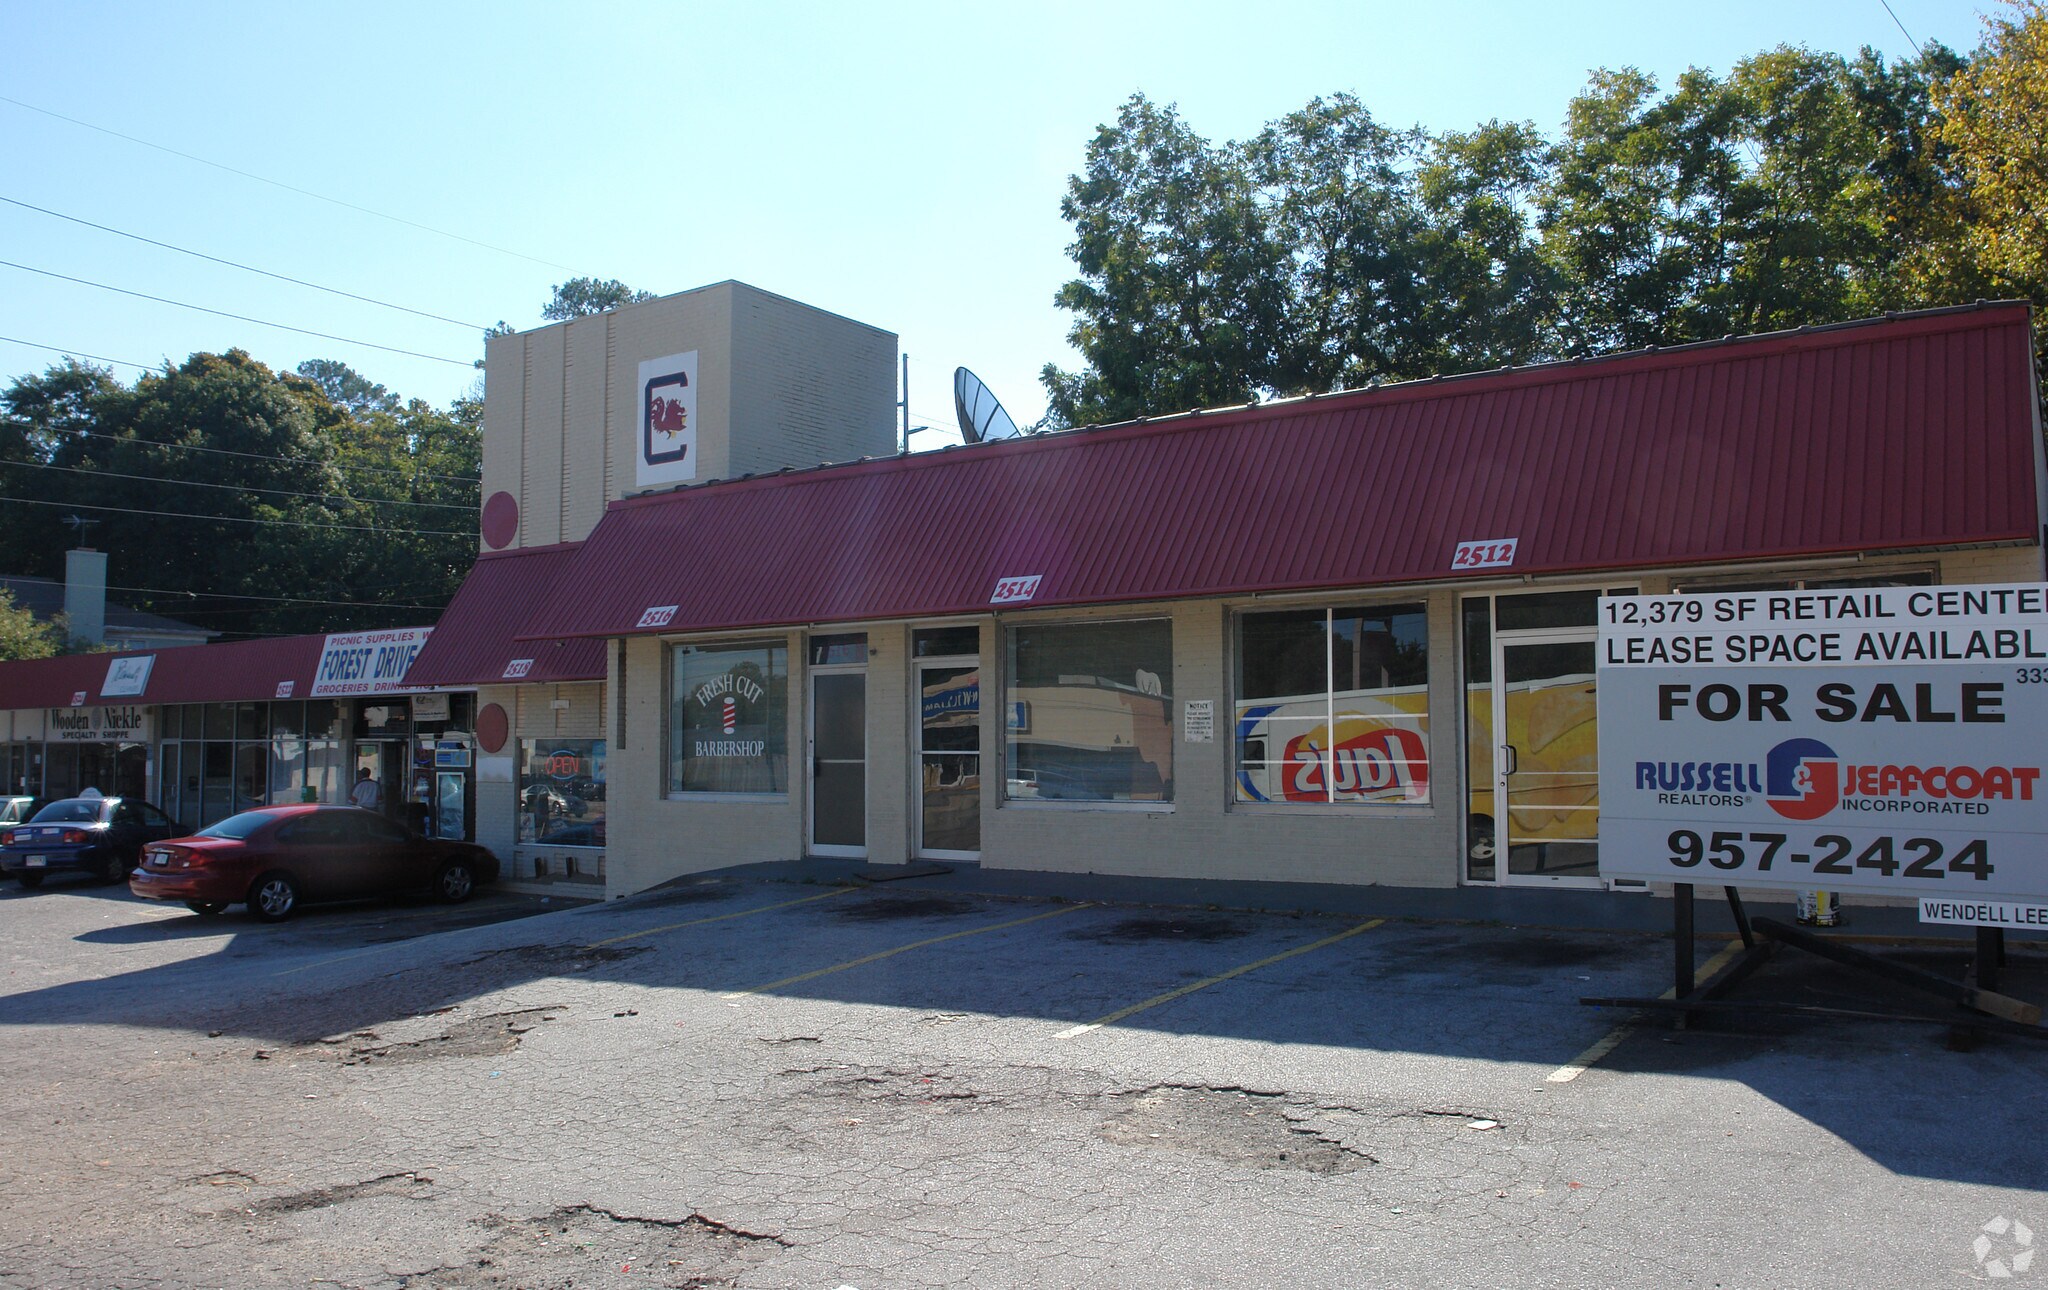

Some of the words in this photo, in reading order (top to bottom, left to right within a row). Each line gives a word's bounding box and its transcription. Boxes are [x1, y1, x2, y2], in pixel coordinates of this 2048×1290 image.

[1455, 544, 1513, 566] 2512
[994, 579, 1038, 599] 2514
[640, 608, 673, 625] 2516
[1606, 600, 1703, 628] 12,379
[1714, 598, 1756, 621] SF
[1769, 594, 1896, 620] RETAIL
[1908, 589, 2048, 617] CENTE
[331, 635, 362, 646] PICNIC
[366, 632, 415, 644] SUPPLIES
[1607, 636, 1714, 664] LEASE
[1725, 633, 1841, 662] SPACE
[1854, 629, 2047, 660] AVAILABL
[320, 648, 373, 681] FOREST
[373, 645, 418, 678] DRIVE
[505, 661, 531, 676] 2518
[316, 683, 369, 694] GROCERIES
[695, 674, 733, 707] FRESH
[736, 675, 764, 704] CUT
[1659, 683, 1792, 722] FOR
[1815, 683, 2006, 722] SALE
[52, 708, 89, 730] Wooden
[104, 707, 142, 728] Nickle
[62, 731, 97, 739] SPECIALTY
[695, 740, 764, 757] BARBERSHOP
[545, 756, 580, 774] OPEN
[1635, 762, 1762, 793] RUSSELL
[1843, 764, 2041, 800] JEFFCOAT
[1842, 799, 1989, 815] INCORPORATED
[1667, 829, 1995, 881] 957-2424
[1924, 903, 2009, 923] WENDELL
[2015, 907, 2048, 924] LEE
